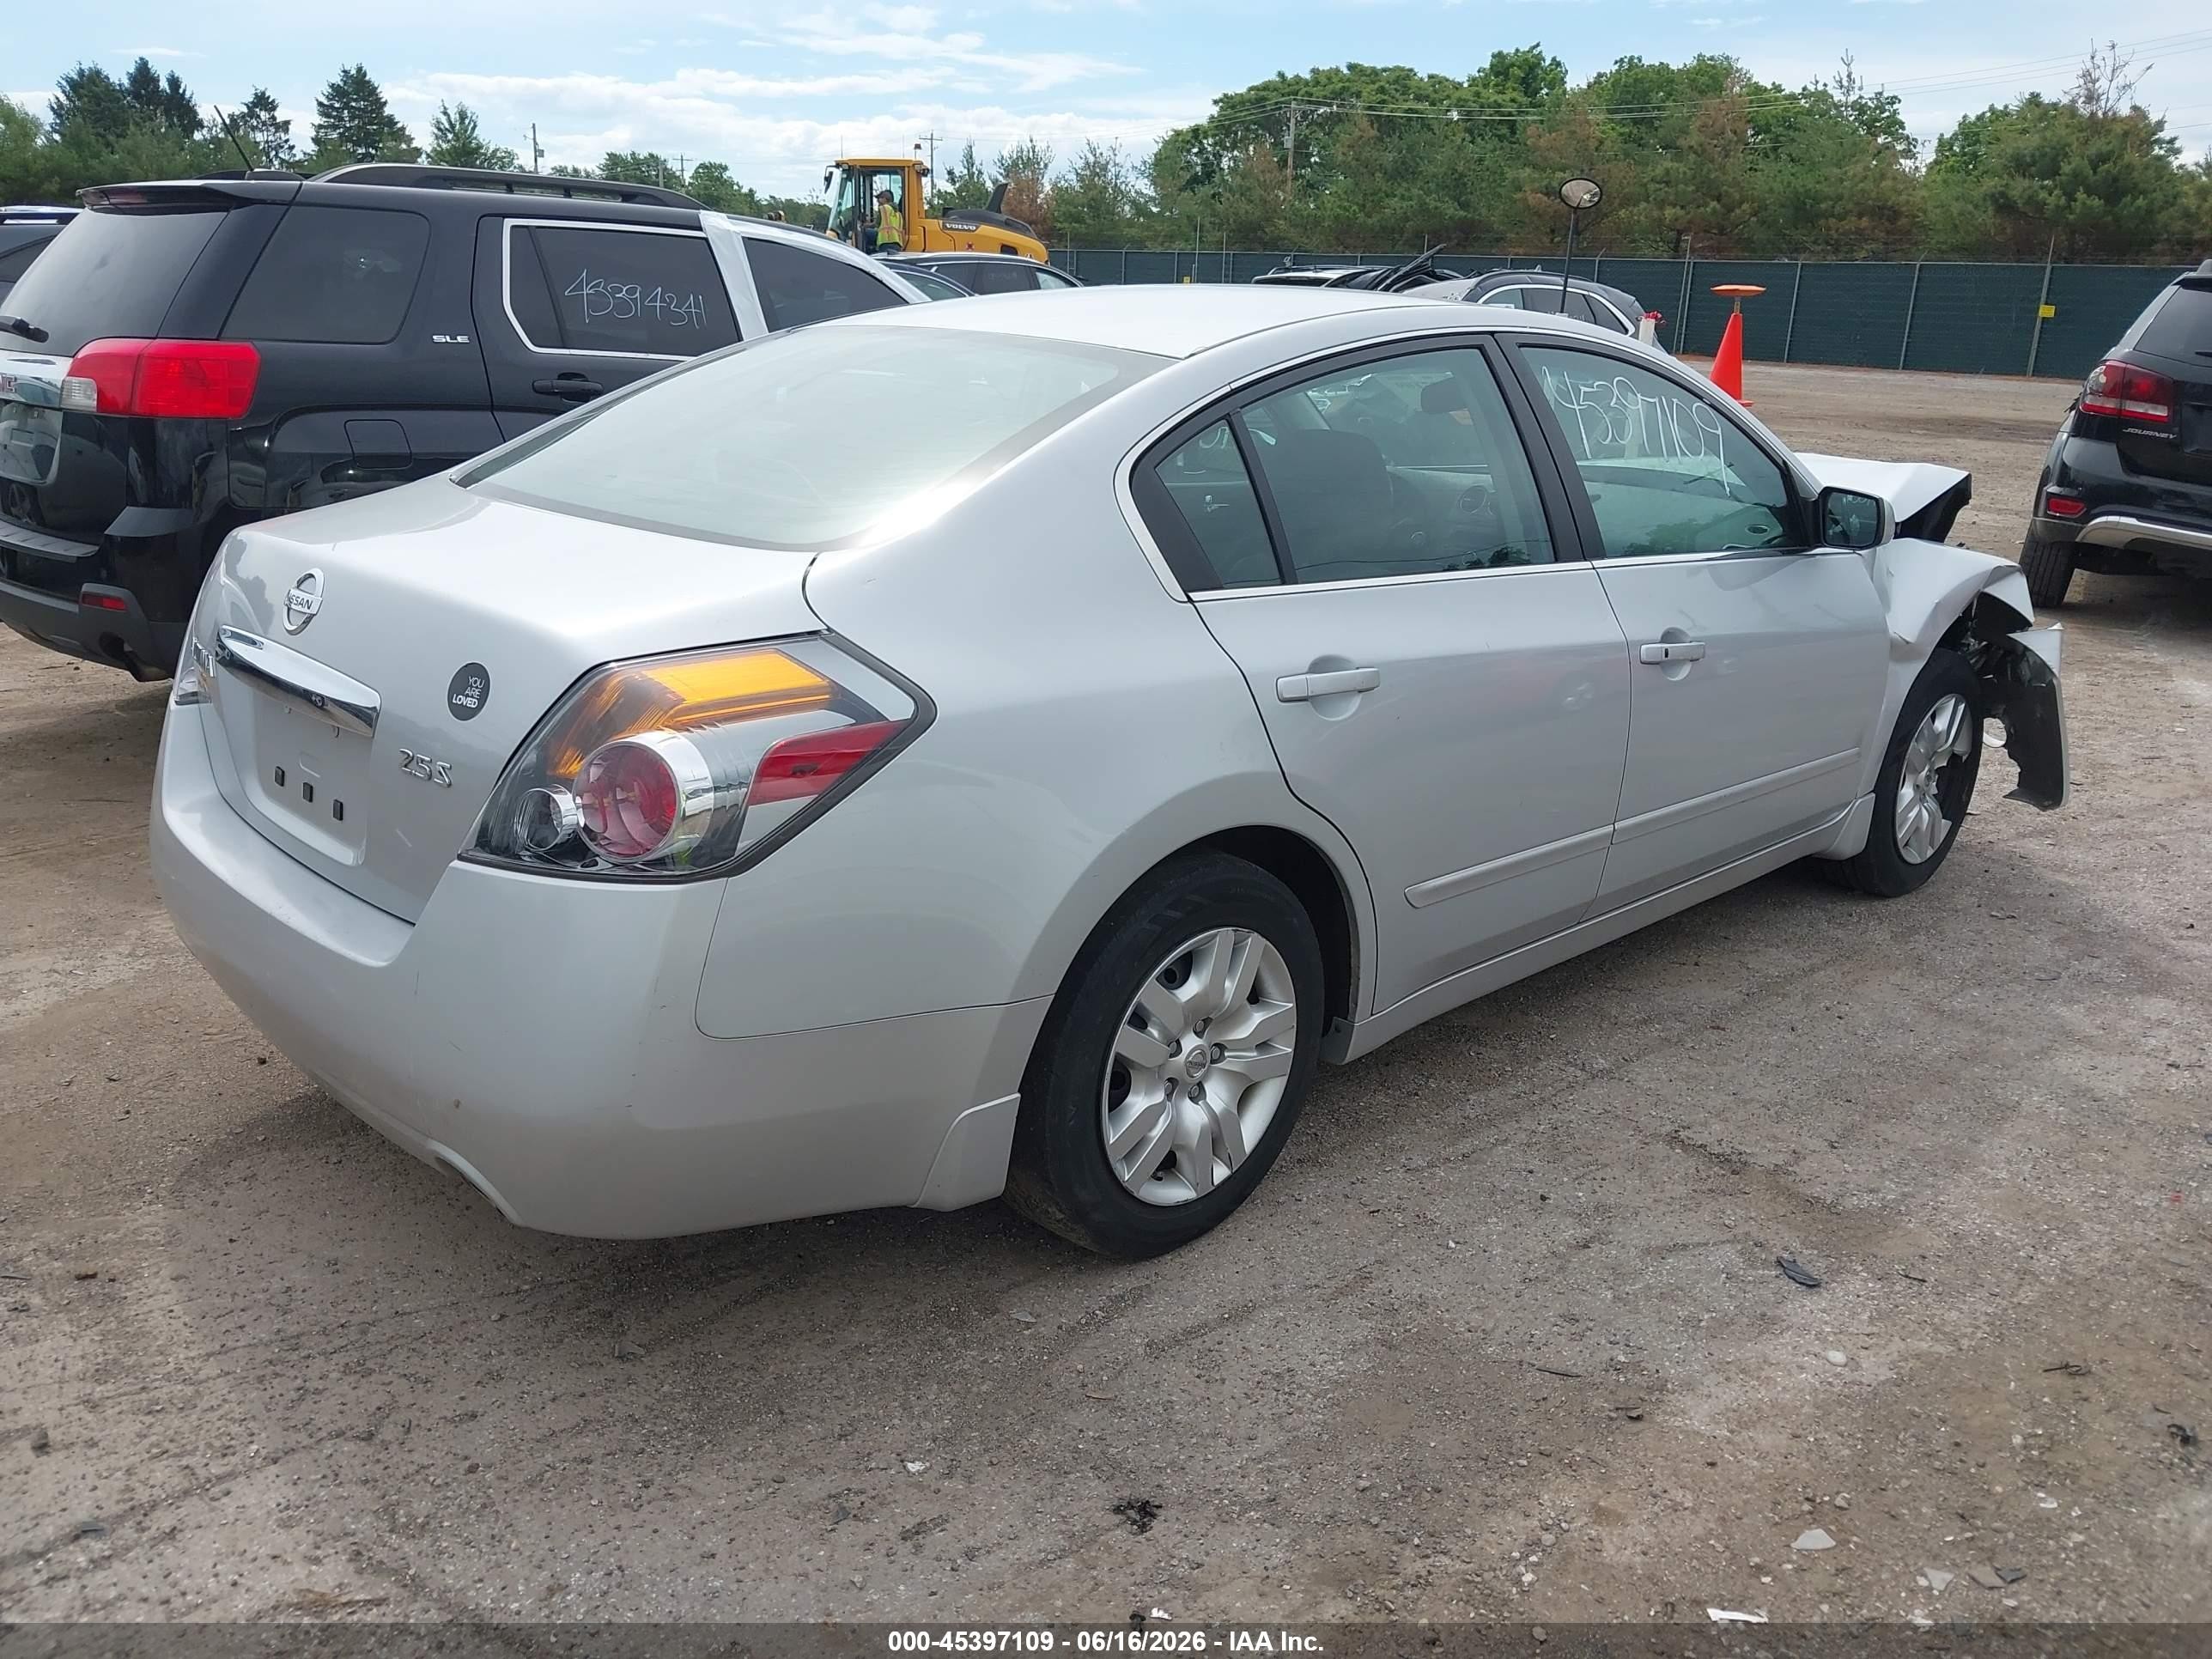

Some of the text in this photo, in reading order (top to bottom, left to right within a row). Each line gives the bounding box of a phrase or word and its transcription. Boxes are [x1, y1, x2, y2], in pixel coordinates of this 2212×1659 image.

[564, 269, 708, 329] 45394341
[432, 335, 471, 343] SLE
[1542, 366, 1731, 497] 45397109
[2122, 428, 2178, 439] JOURNEY
[468, 676, 485, 689] YOU
[464, 686, 482, 699] ARE
[452, 693, 479, 708] LOVED
